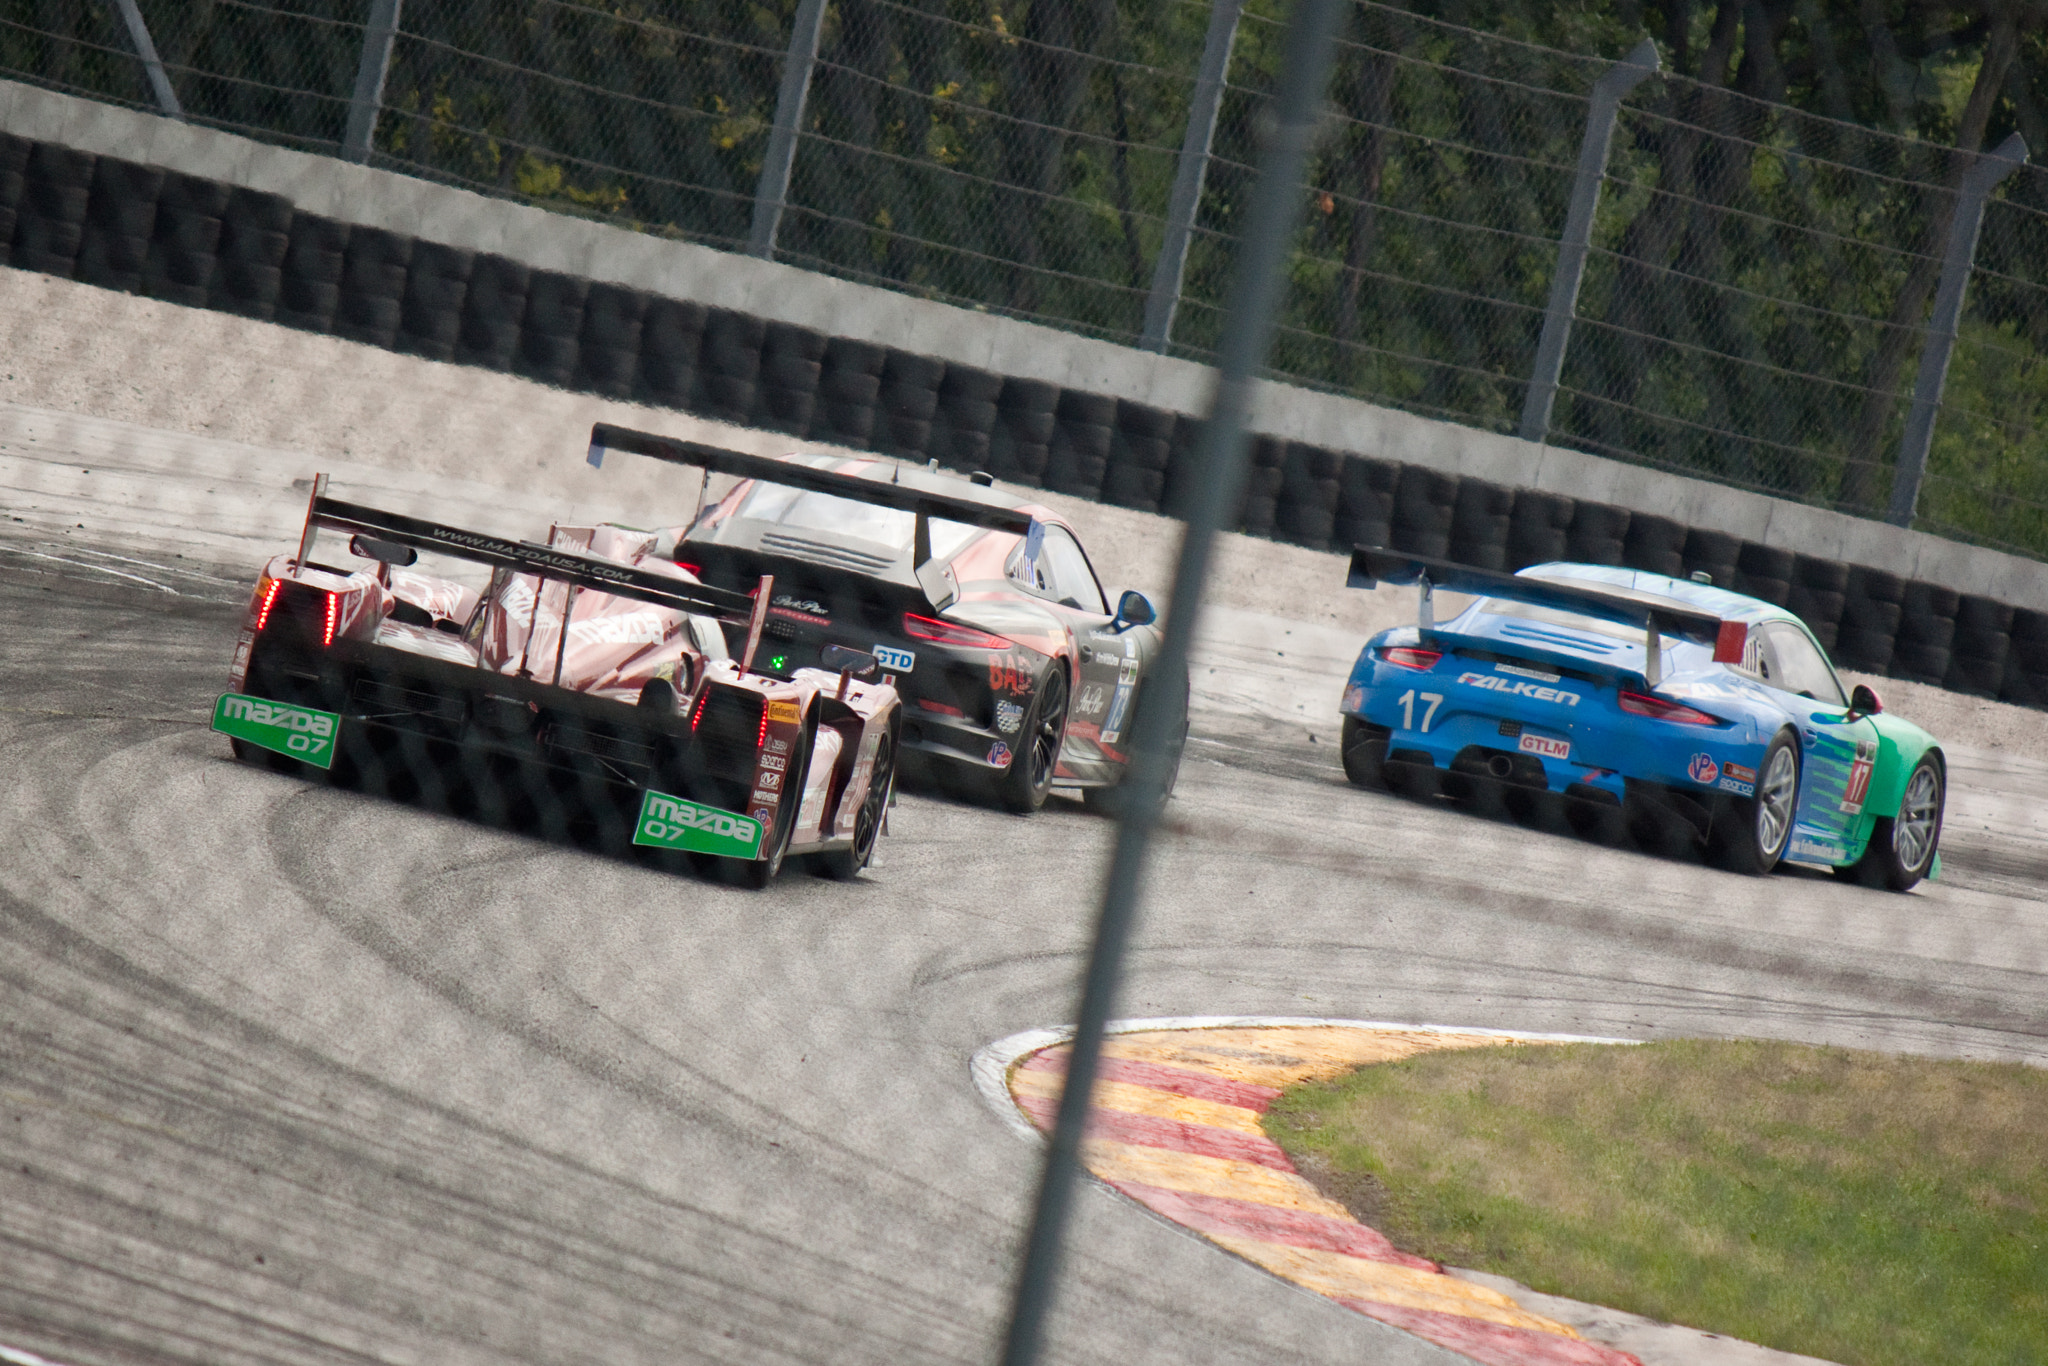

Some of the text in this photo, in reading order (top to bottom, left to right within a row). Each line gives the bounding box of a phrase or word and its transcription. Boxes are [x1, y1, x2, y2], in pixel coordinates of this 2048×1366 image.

[432, 528, 634, 581] WWW.MAZDAUSA.COM
[875, 649, 913, 669] GTD
[1457, 672, 1582, 706] FALKEN
[223, 696, 334, 738] mazda
[1398, 689, 1444, 733] 17
[286, 733, 329, 754] 07
[1522, 736, 1569, 756] GTLM
[760, 754, 786, 769] sparco
[1719, 777, 1755, 794] sparco
[1849, 763, 1871, 802] 17
[643, 821, 686, 842] 07
[647, 796, 756, 843] mazda
